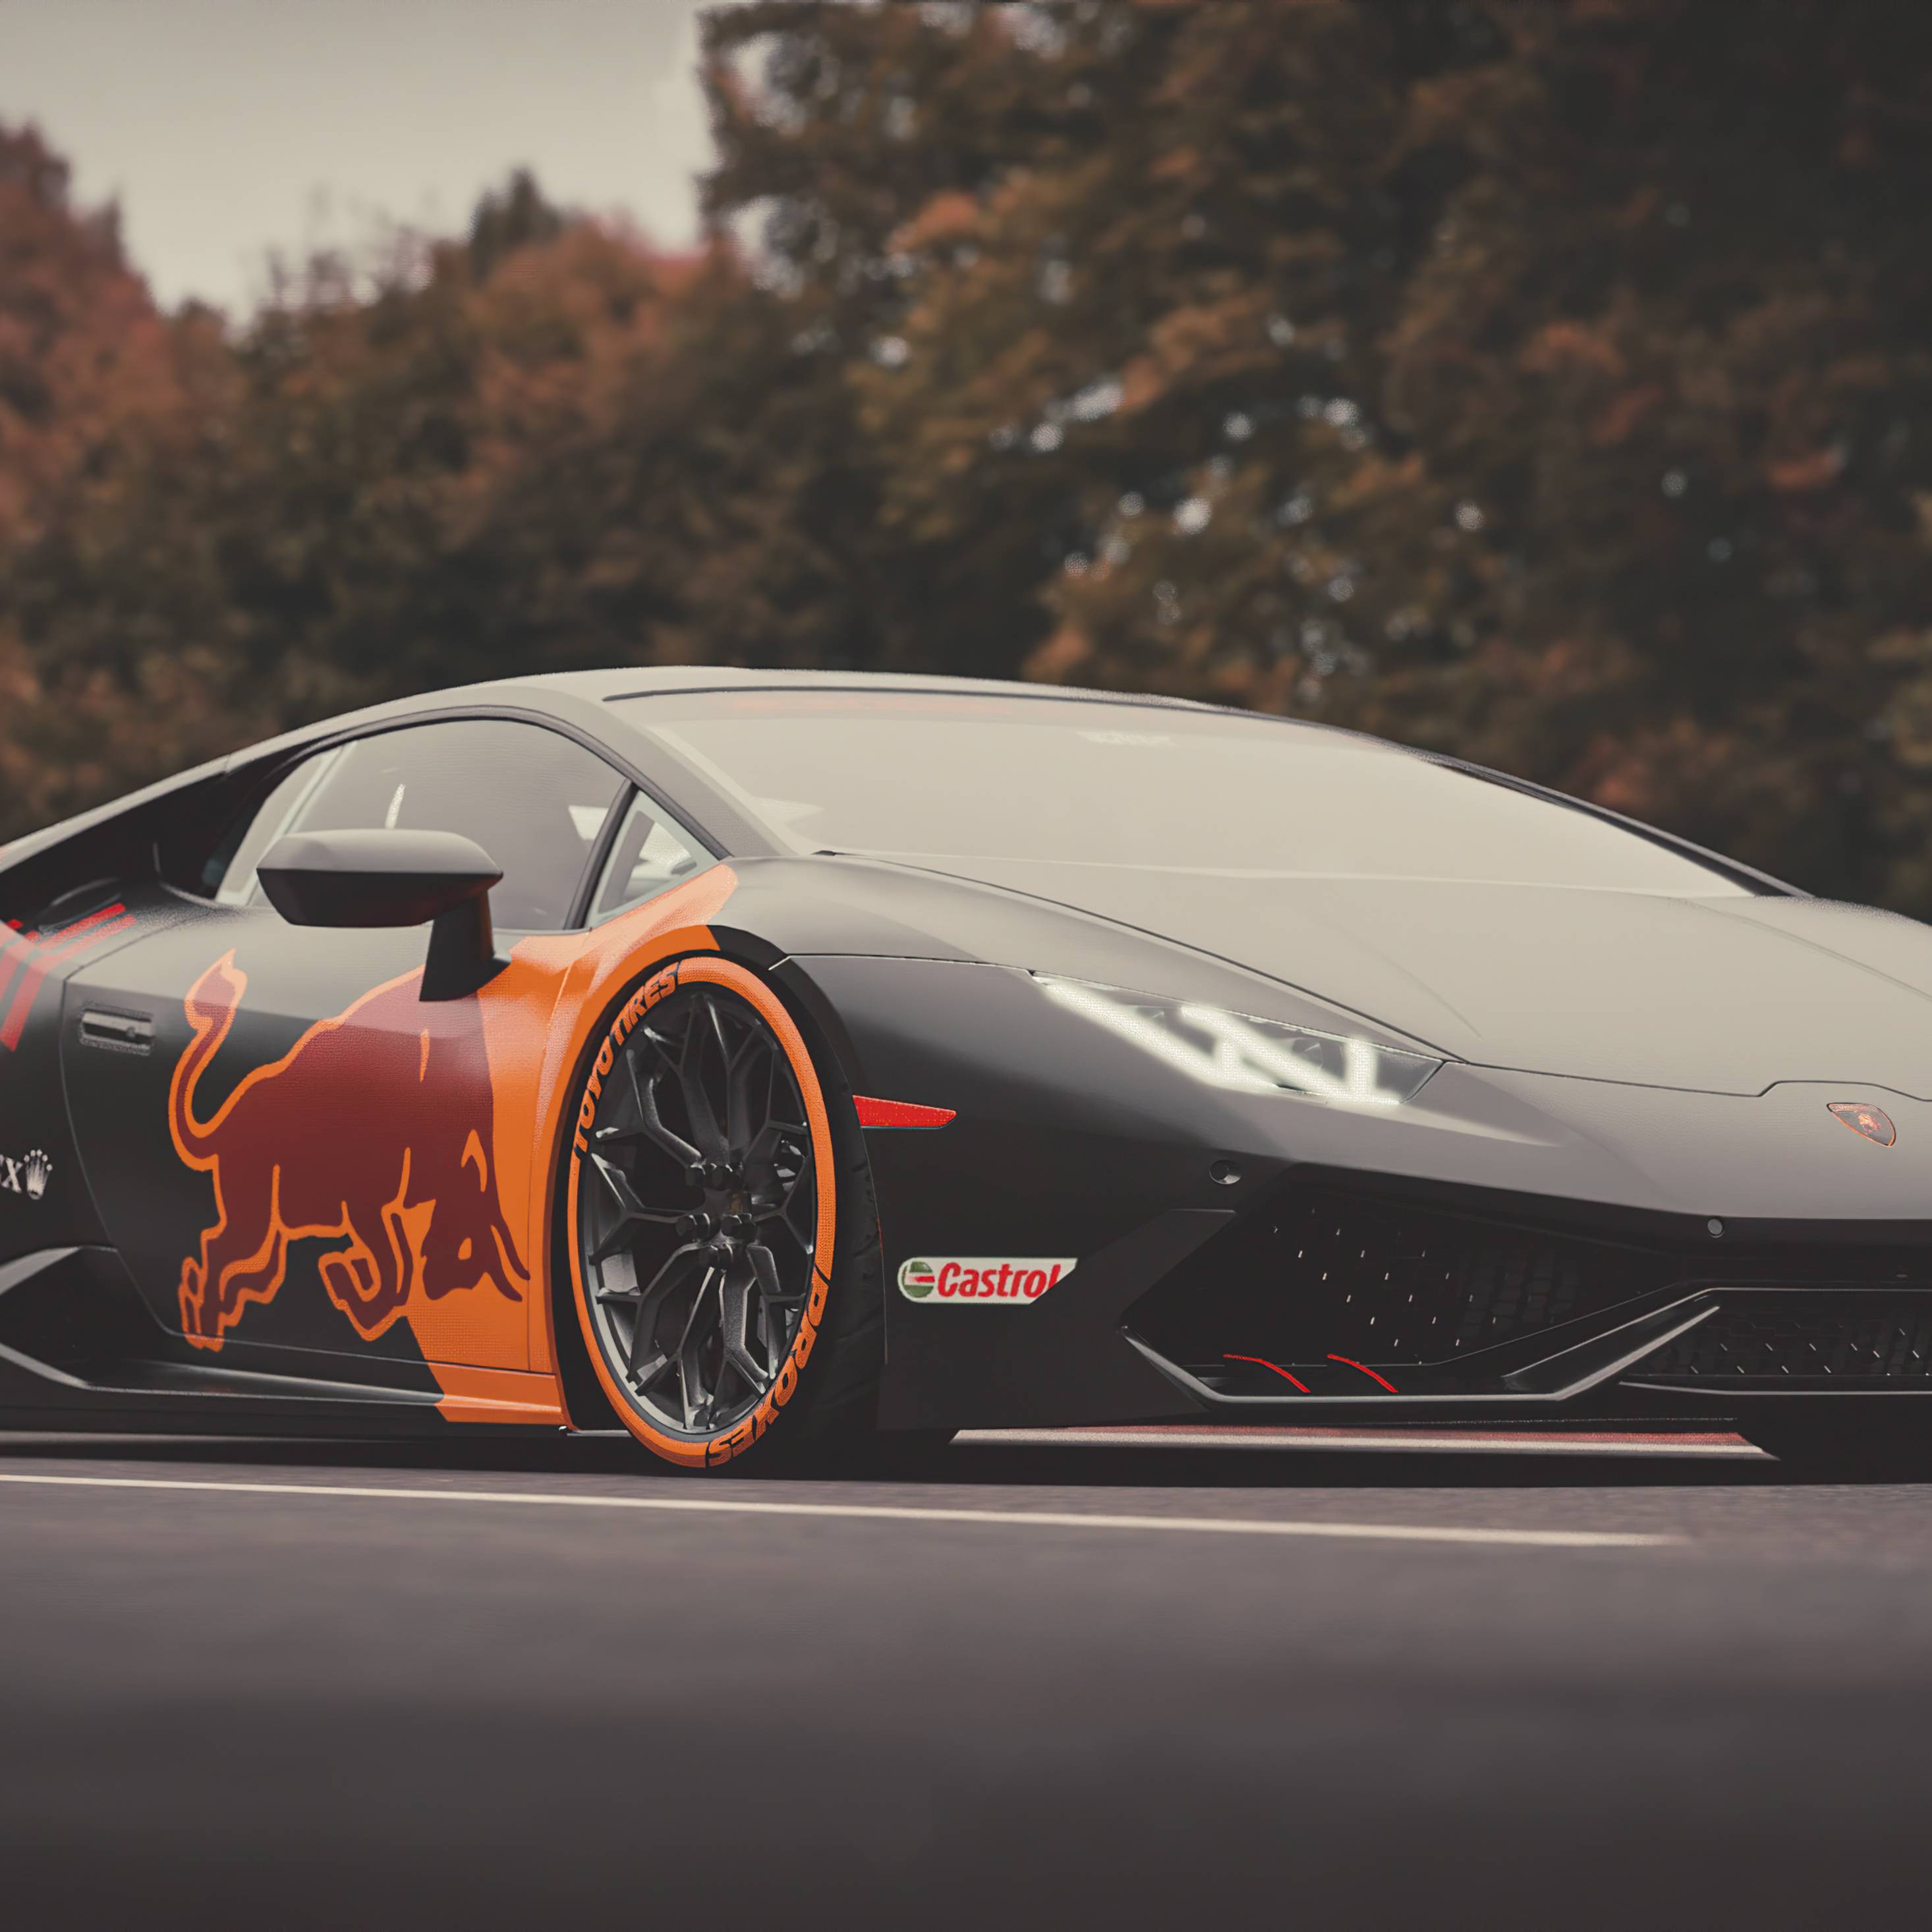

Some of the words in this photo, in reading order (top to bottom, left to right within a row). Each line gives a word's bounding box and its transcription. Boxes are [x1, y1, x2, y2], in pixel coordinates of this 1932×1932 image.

[574, 1035, 614, 1154] TOYO
[610, 961, 679, 1047] TIRES
[0, 1154, 23, 1193] X
[937, 1262, 1061, 1297] Castrol
[708, 1264, 830, 1467] PROXES
